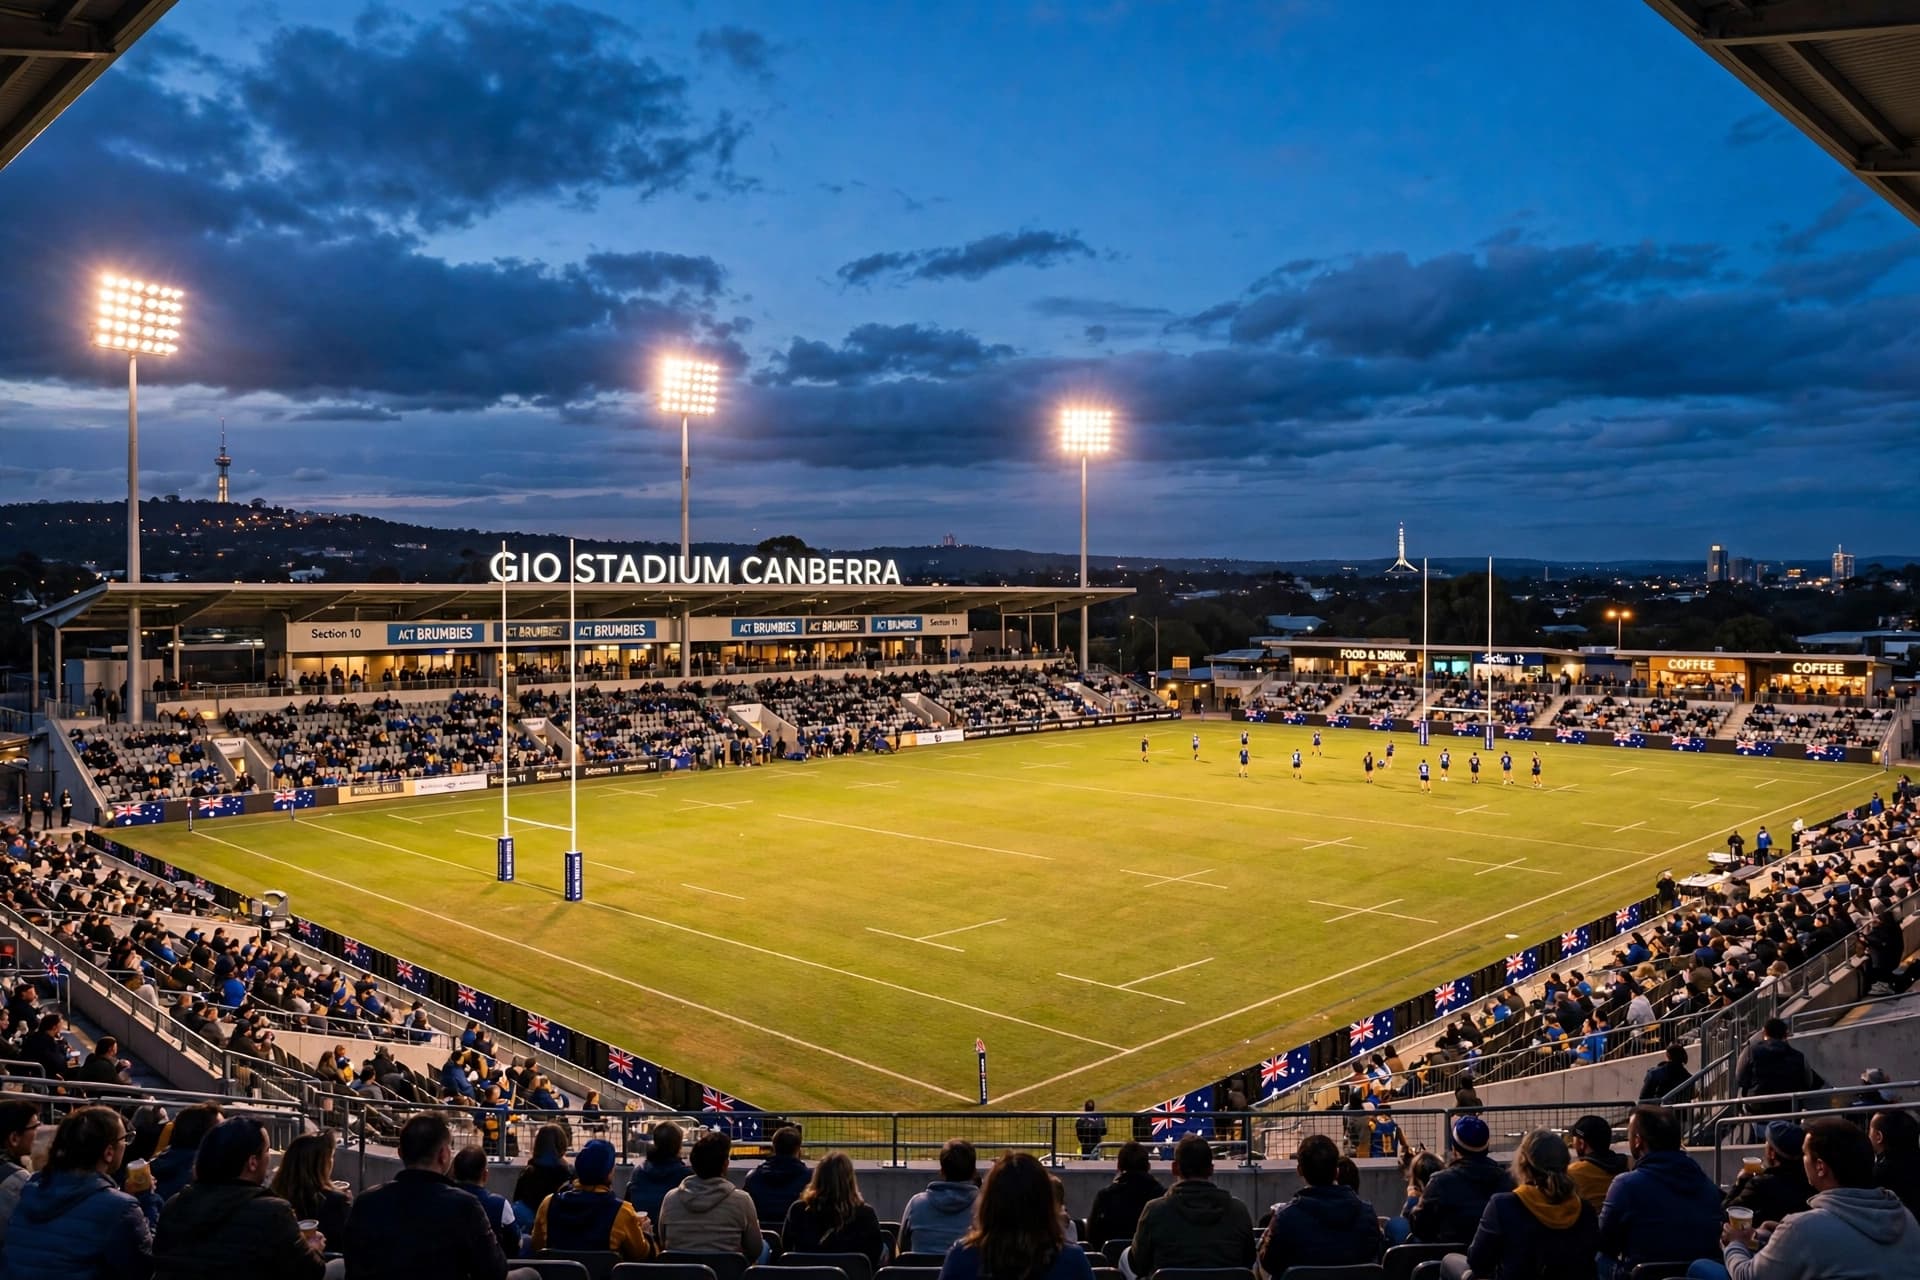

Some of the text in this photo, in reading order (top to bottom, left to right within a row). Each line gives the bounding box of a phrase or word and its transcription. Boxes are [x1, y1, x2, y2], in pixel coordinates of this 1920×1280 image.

[490, 551, 901, 585] GIO STADIUM CANBERRA
[311, 628, 361, 639] Section 10
[398, 627, 473, 641] ACT BRUMBIES
[579, 624, 646, 637] ACT BRUMBIES
[739, 621, 796, 634] ACT BRUMBIES
[1340, 649, 1407, 661] FOOD & DRINK
[1515, 654, 1525, 664] 12
[1668, 659, 1716, 671] COFFEE
[1793, 662, 1844, 675] COFFEE
